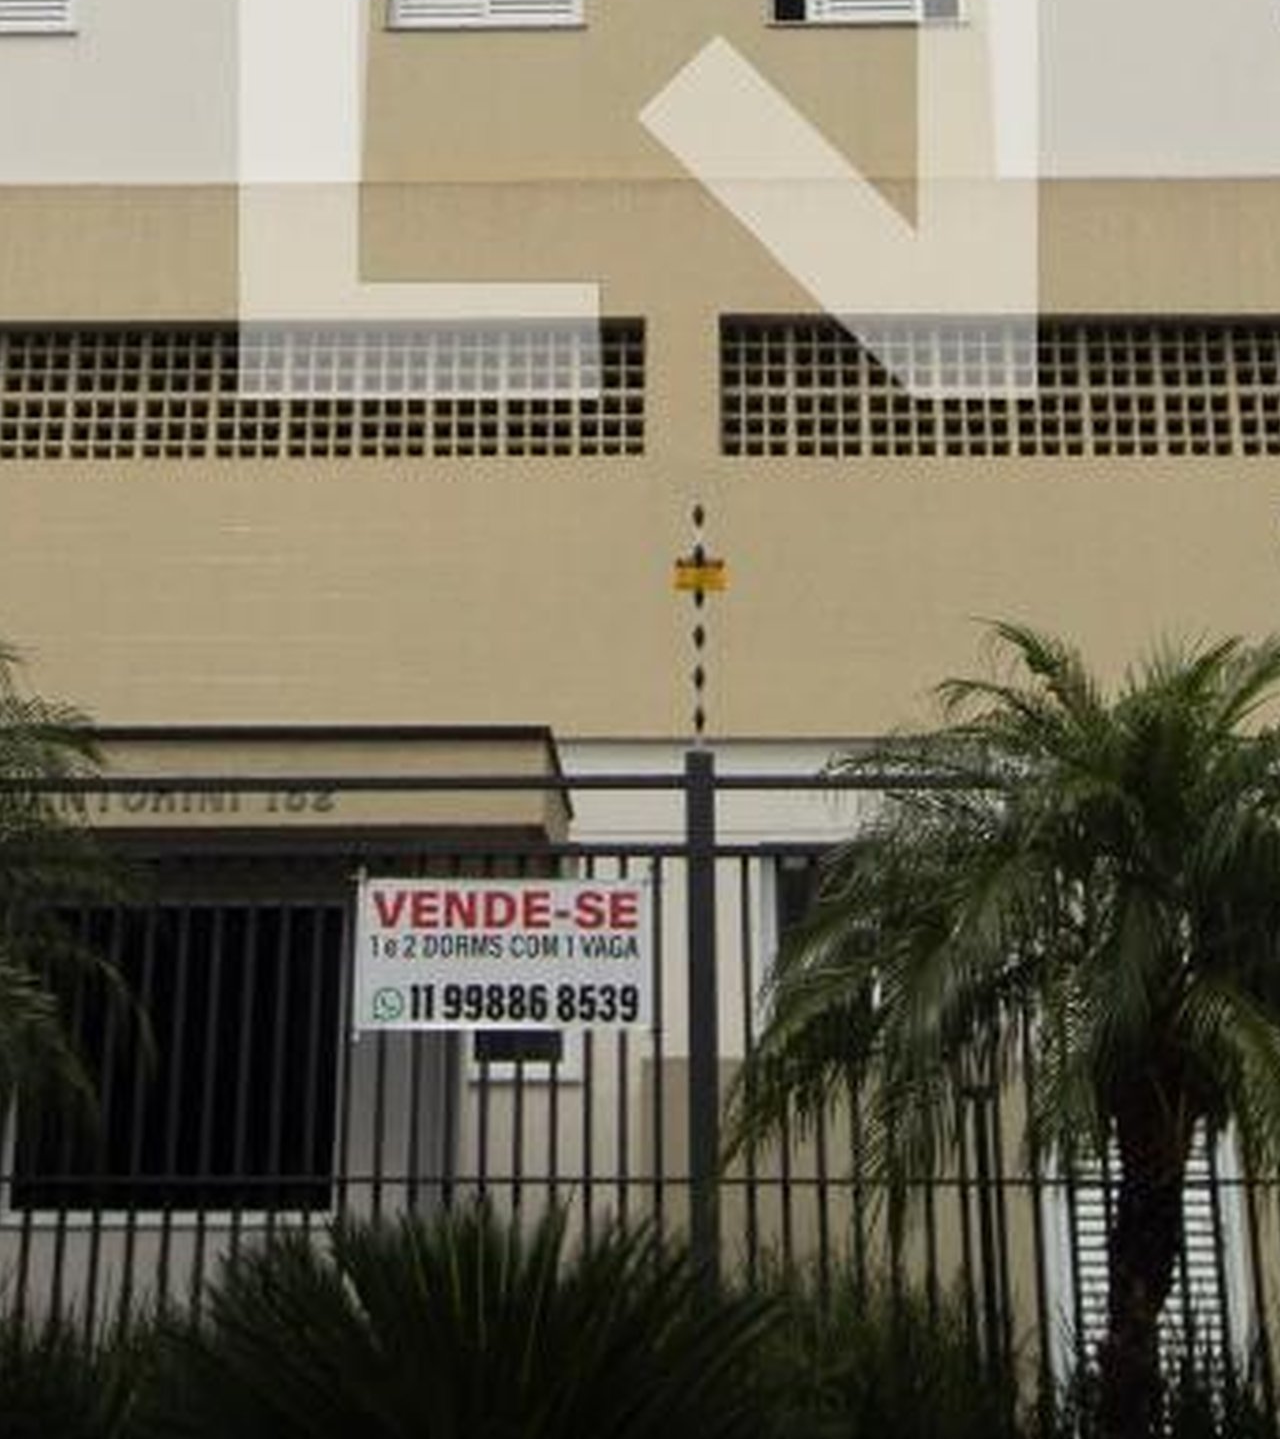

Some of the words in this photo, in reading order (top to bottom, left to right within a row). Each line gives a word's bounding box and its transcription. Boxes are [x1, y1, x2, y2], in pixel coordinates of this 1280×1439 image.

[372, 889, 639, 930] VENDE-SE
[403, 934, 417, 959] 2
[422, 934, 505, 959] DORMS
[510, 934, 560, 959] COM
[579, 935, 640, 959] VAGA
[410, 983, 436, 1022] 11
[442, 983, 549, 1023] 99886
[556, 983, 640, 1023] 8539
